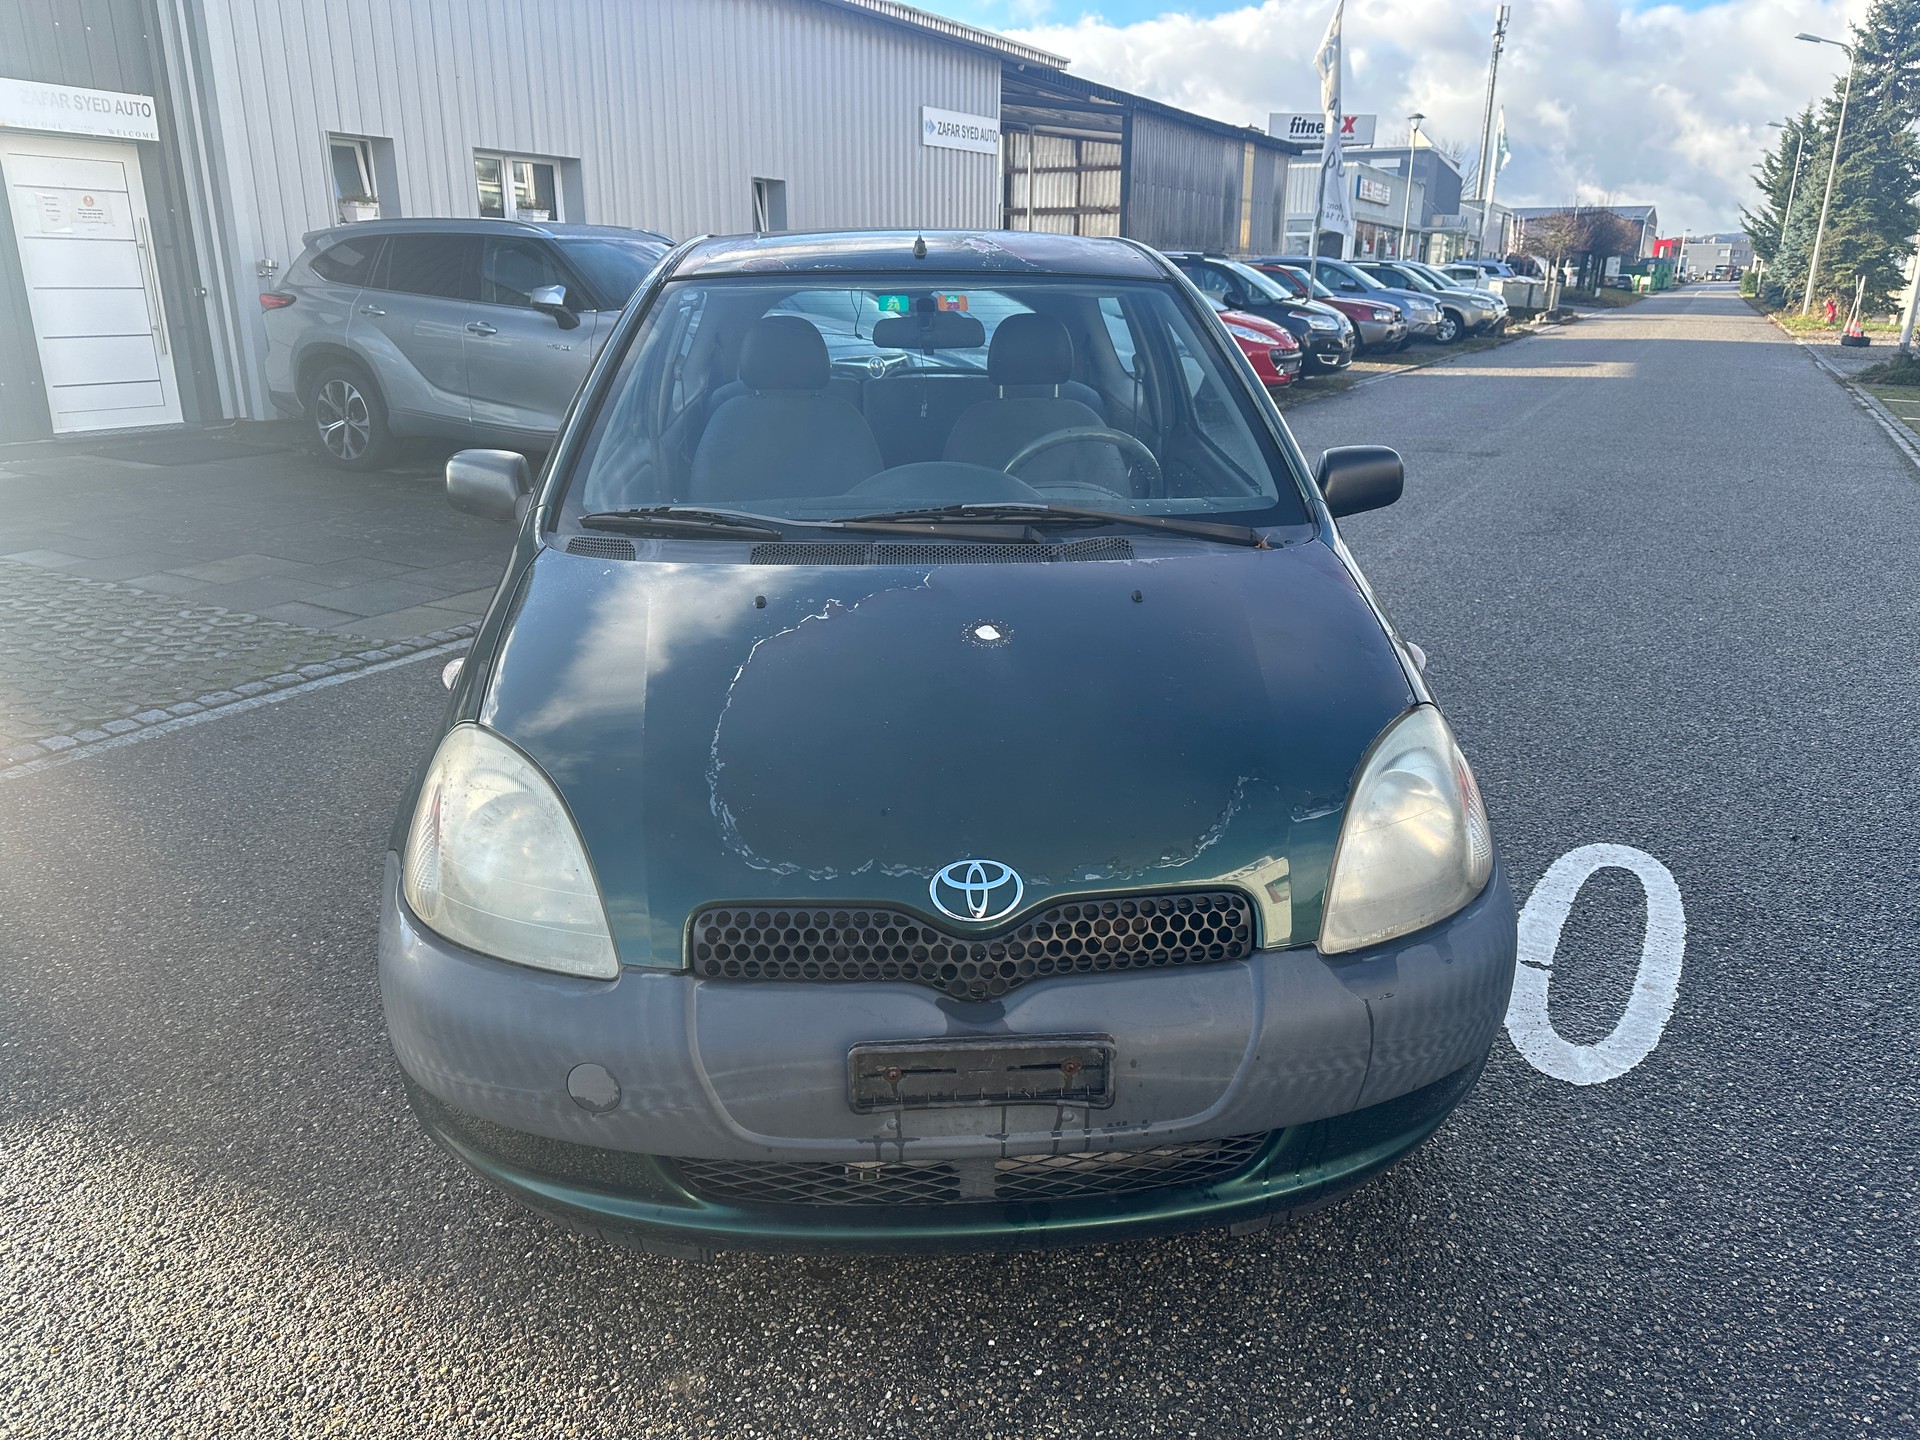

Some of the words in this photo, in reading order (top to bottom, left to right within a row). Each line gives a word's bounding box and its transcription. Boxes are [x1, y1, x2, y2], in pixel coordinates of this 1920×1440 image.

[73, 94, 111, 113] SYED
[115, 100, 152, 118] AUTO
[107, 128, 156, 139] WELCOME
[937, 121, 960, 138] ZAFAR
[961, 125, 979, 140] SYED
[980, 128, 997, 143] AUTO
[1289, 116, 1325, 133] fitne
